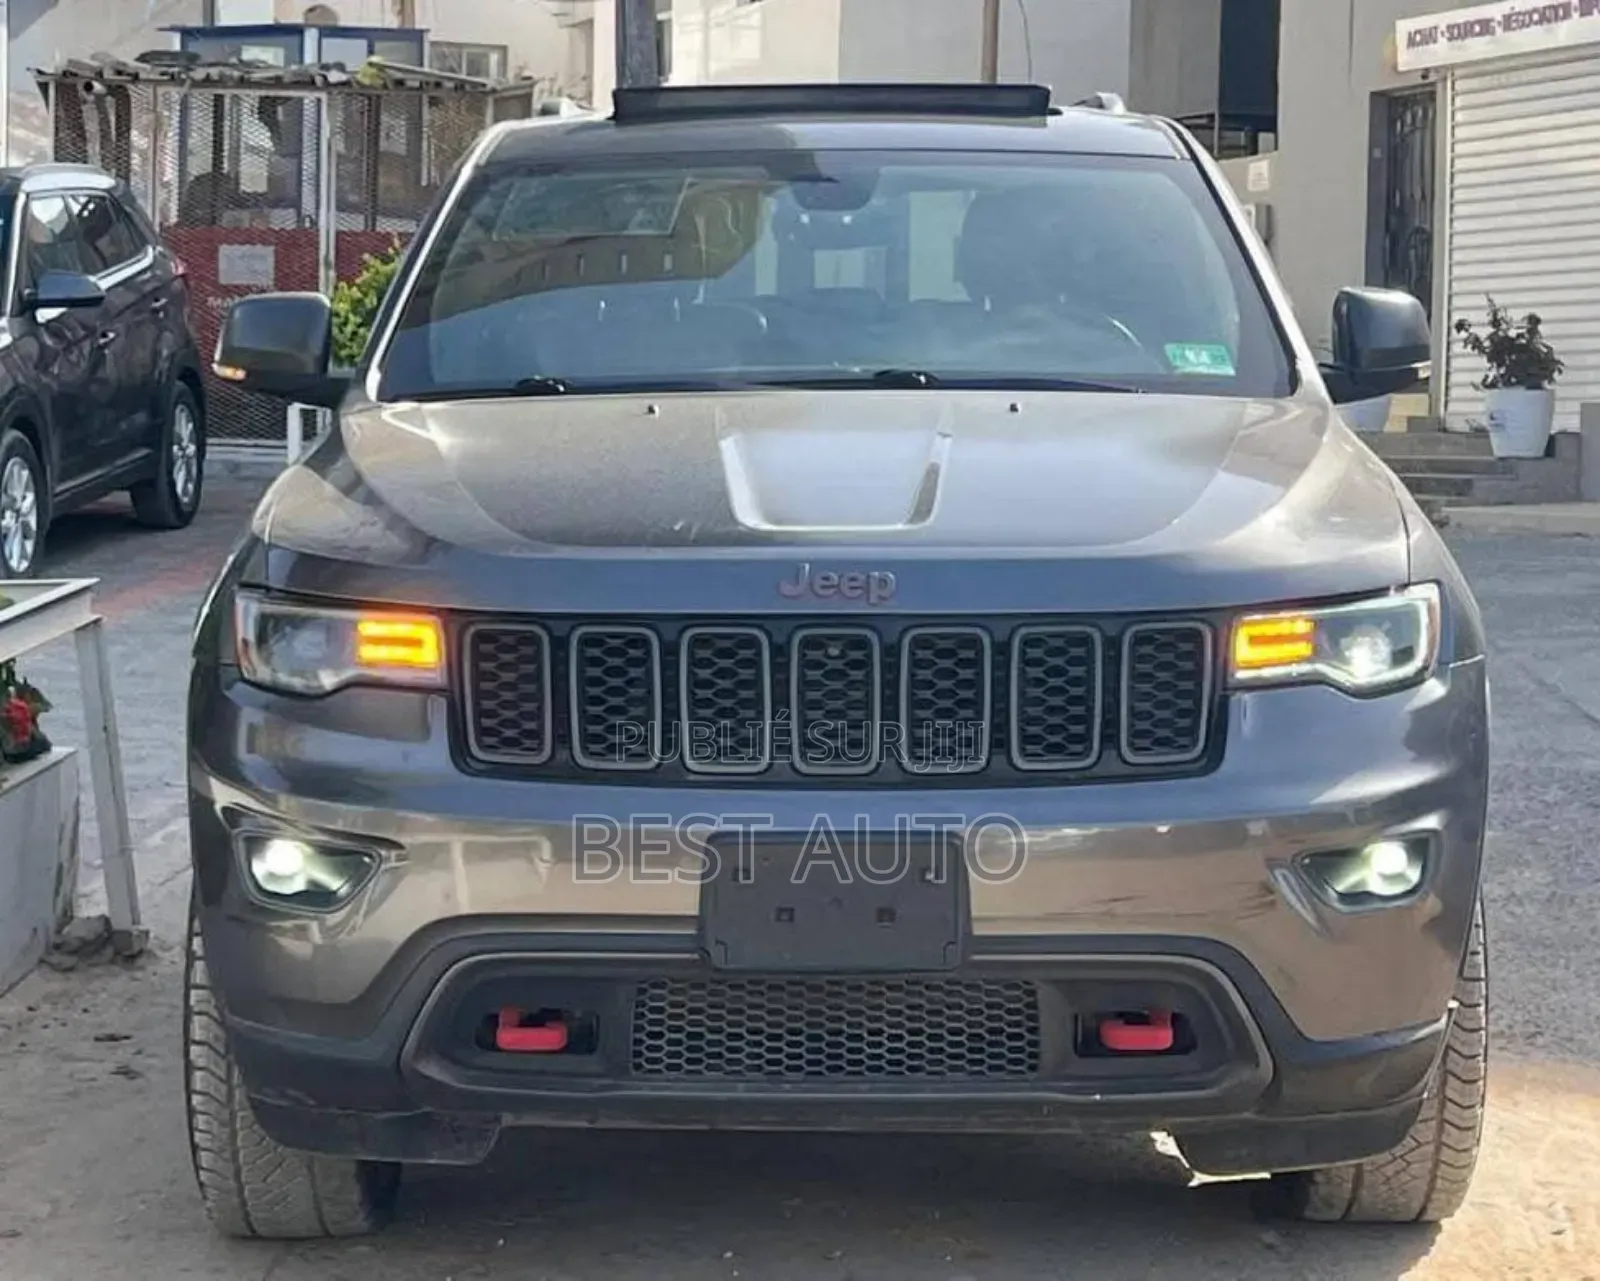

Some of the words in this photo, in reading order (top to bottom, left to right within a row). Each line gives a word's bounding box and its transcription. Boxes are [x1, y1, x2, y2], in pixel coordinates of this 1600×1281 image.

[1407, 26, 1439, 49] ACHAT
[1446, 17, 1496, 42] SOURCING
[777, 562, 897, 605] Jeep
